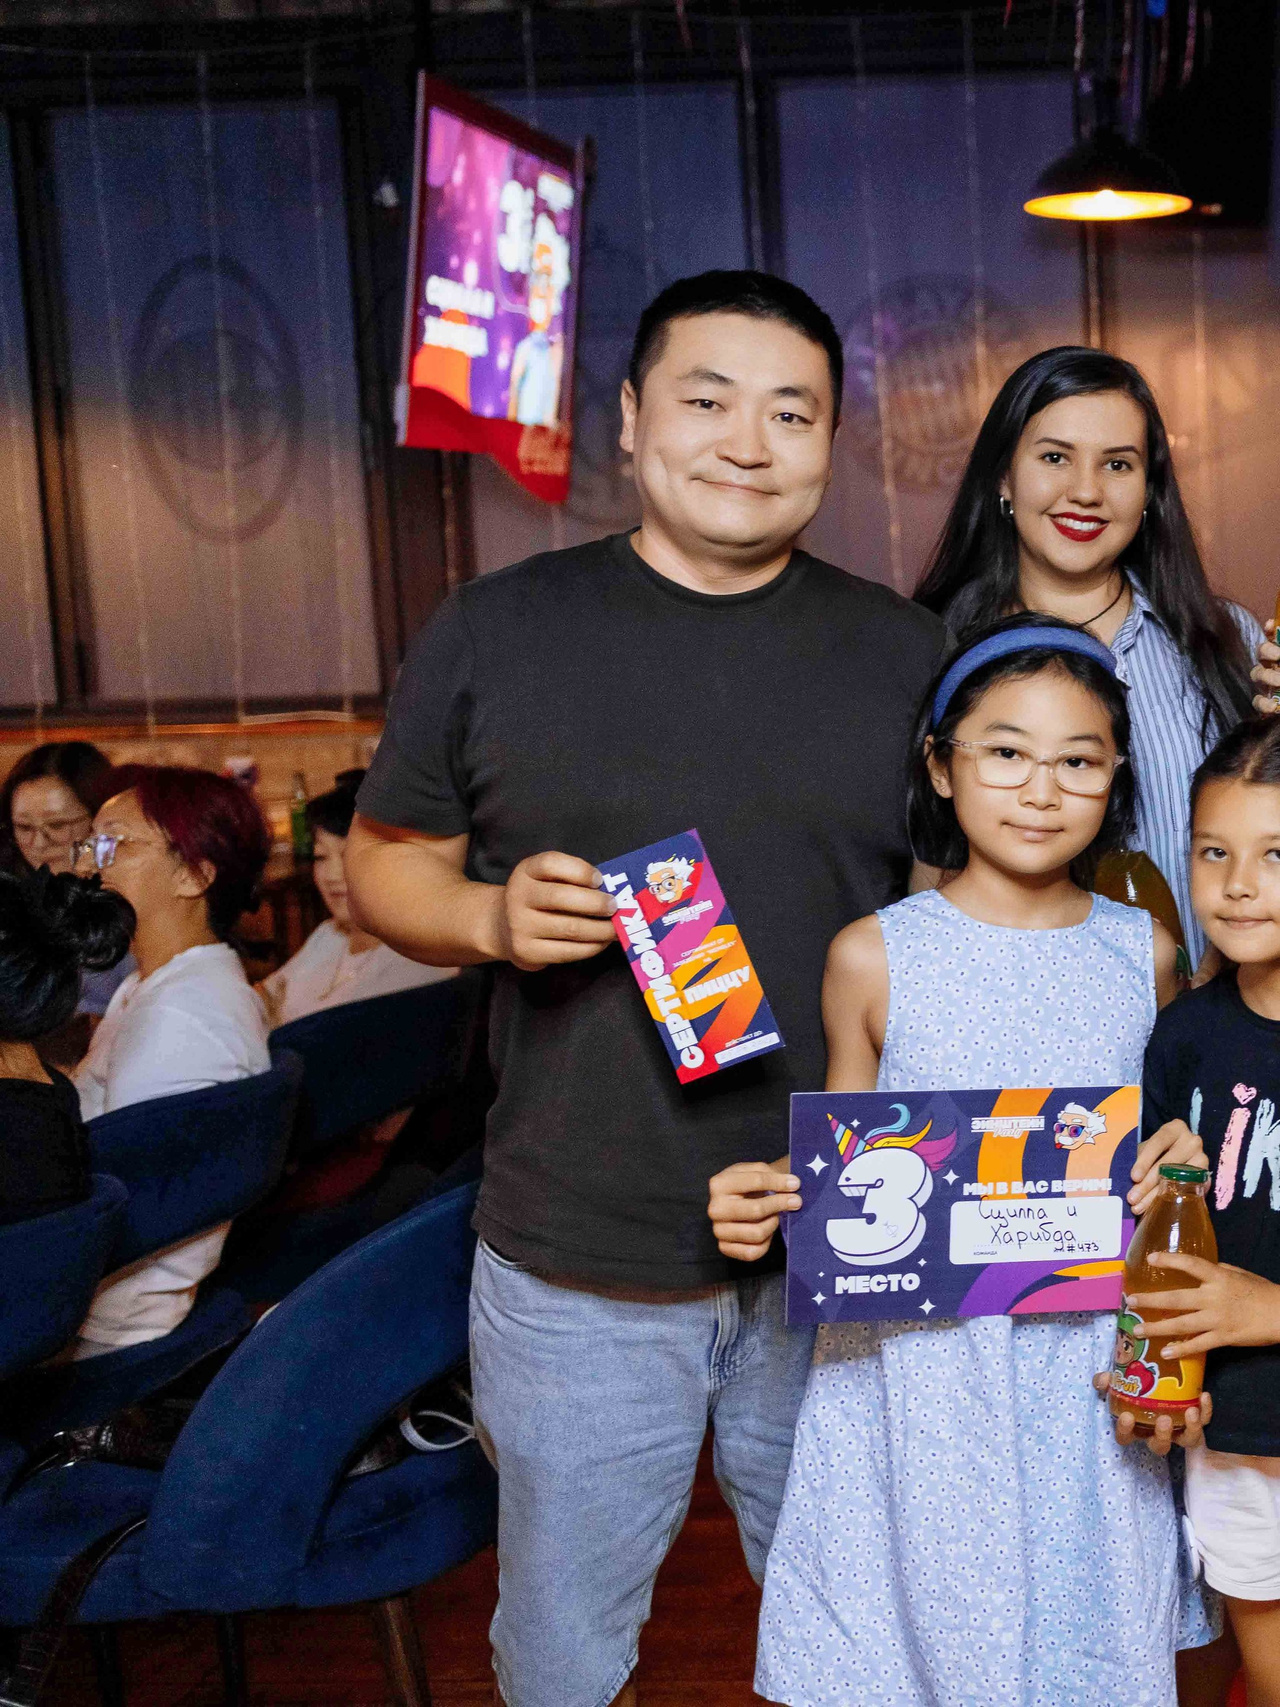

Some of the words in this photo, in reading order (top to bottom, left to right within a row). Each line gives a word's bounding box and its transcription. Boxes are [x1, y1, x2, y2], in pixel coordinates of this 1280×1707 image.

[602, 872, 705, 1069] СЕРТИФИКАТ
[683, 965, 750, 1005] ПИЦЦУ
[963, 1182, 994, 1196] МЫ
[996, 1181, 1009, 1195] В
[1011, 1180, 1049, 1194] ВАС
[990, 1222, 1077, 1252] Харибда
[835, 1272, 920, 1295] МЕСТО
